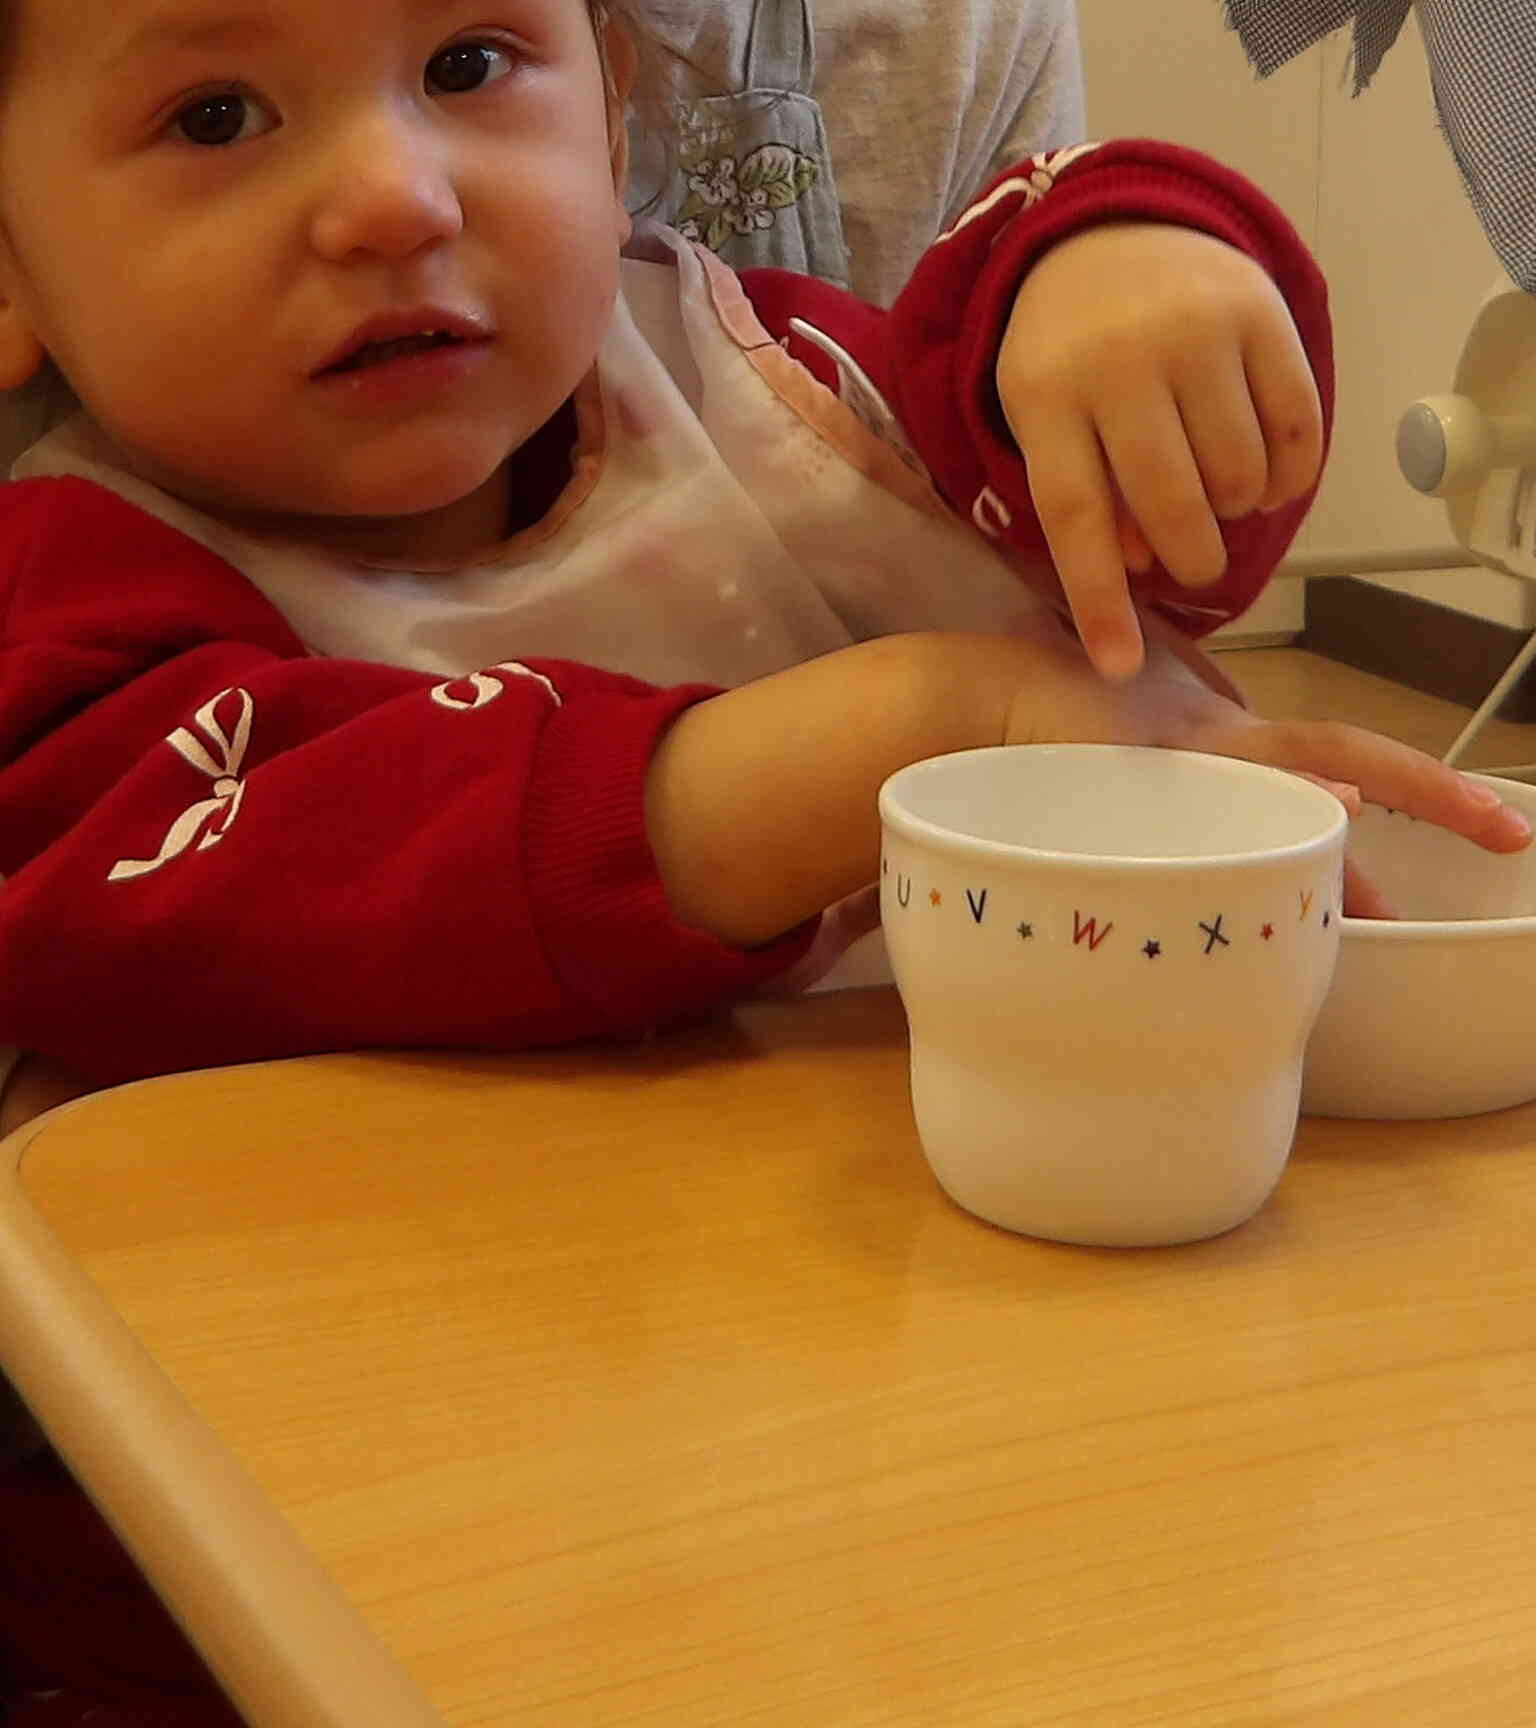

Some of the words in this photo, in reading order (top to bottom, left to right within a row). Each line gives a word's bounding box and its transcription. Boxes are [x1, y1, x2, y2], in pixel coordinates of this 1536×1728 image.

[897, 873, 912, 909] U
[966, 888, 989, 924] V
[1072, 909, 1114, 953] W
[1198, 914, 1230, 955] X
